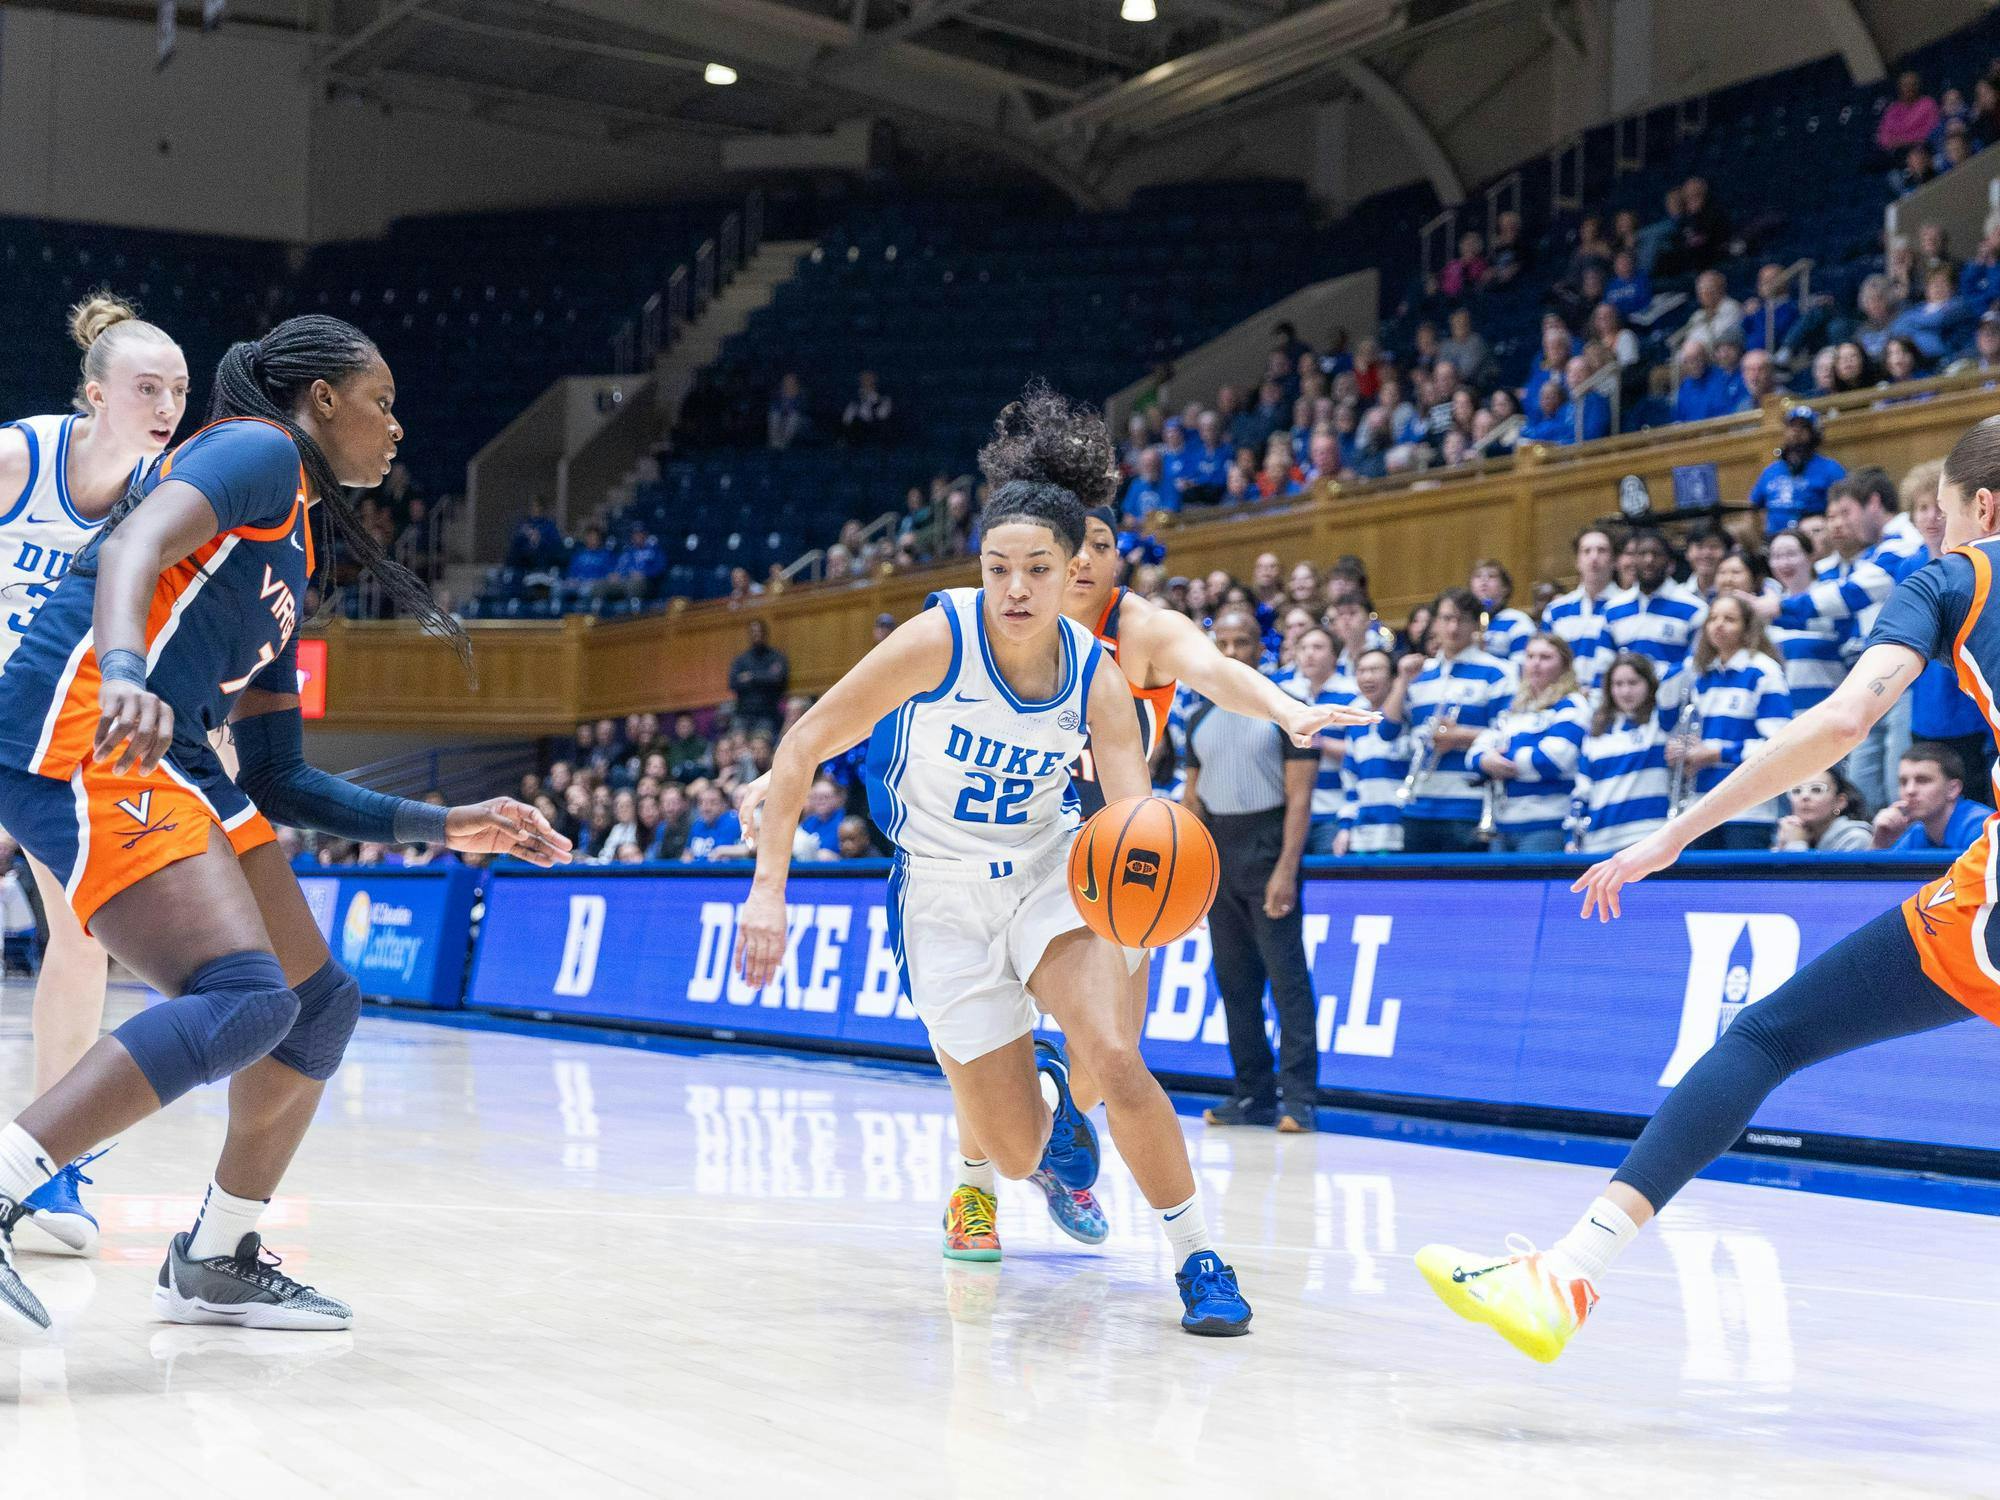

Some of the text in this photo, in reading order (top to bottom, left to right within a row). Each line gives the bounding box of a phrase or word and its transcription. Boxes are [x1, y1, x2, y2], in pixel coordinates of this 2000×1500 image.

[13, 541, 74, 579] DU
[260, 563, 296, 641] VIRG
[944, 724, 1066, 777] DUKE
[953, 772, 1034, 825] 22
